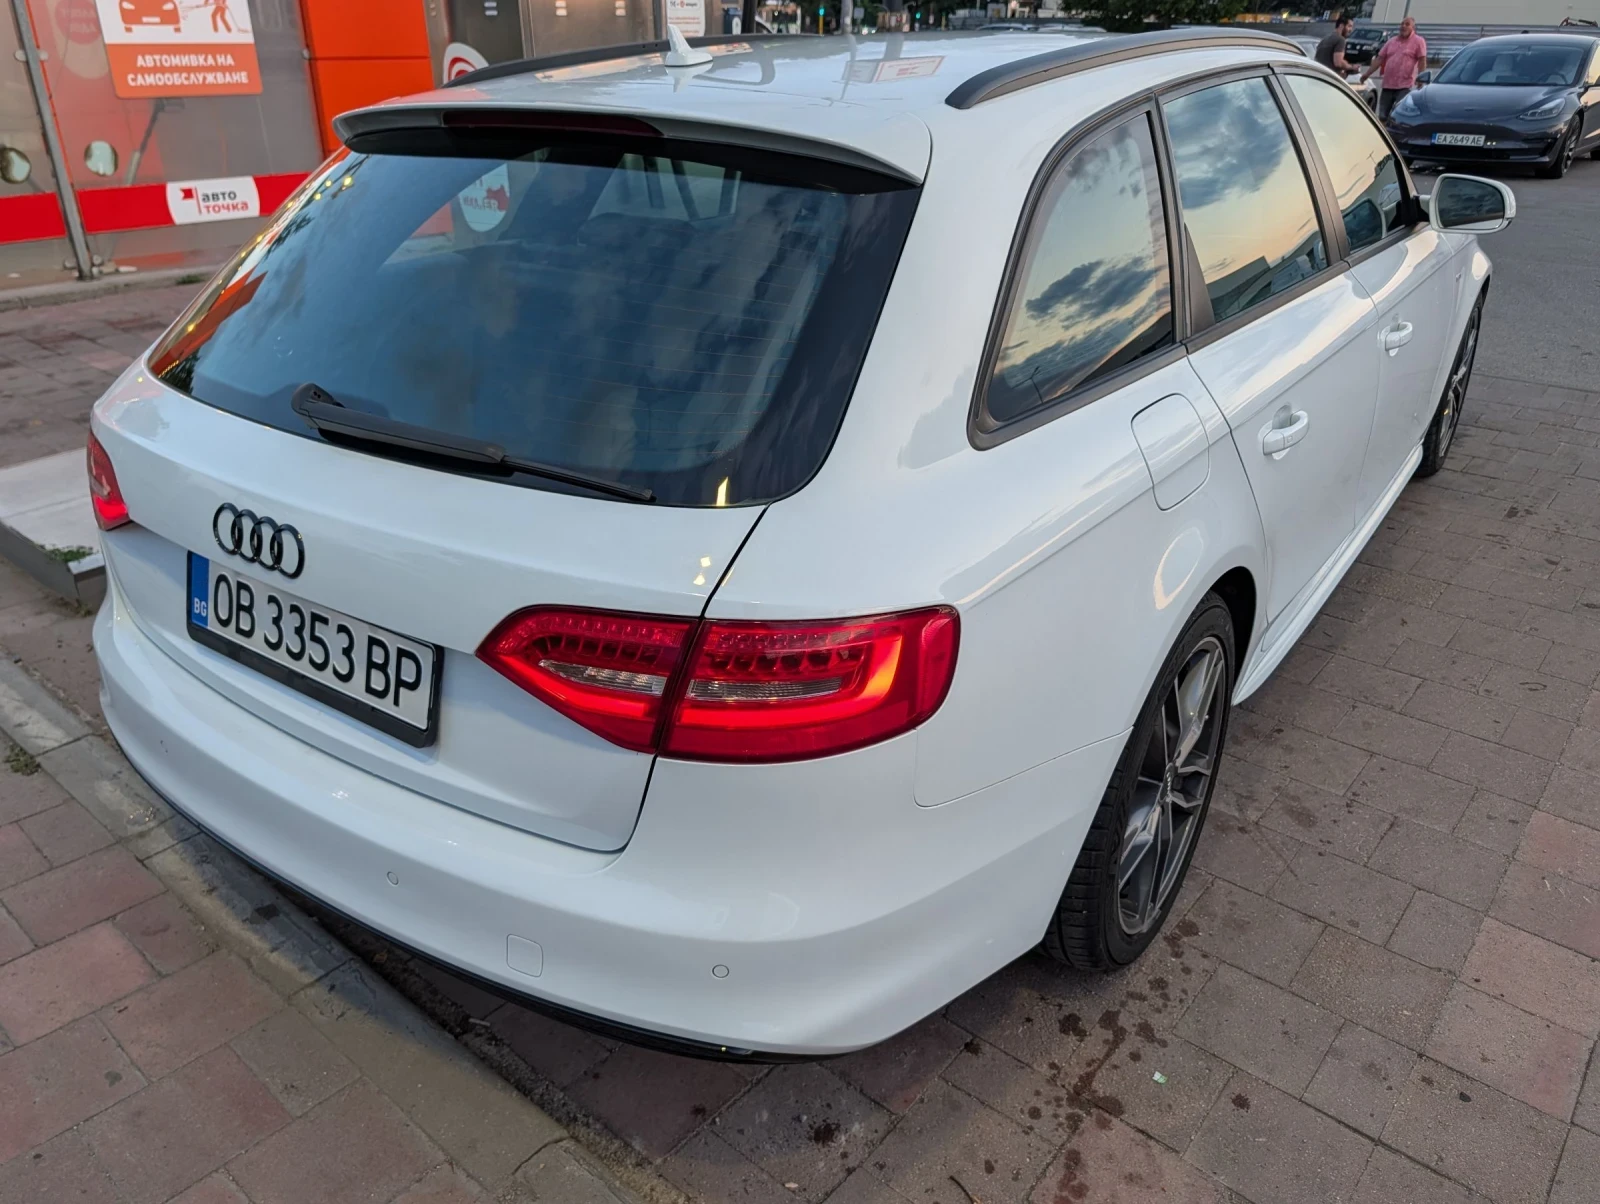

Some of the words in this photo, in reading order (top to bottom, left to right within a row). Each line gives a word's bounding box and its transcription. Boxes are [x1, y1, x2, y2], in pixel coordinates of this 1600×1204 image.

[137, 54, 215, 68] АВТОМИВКА
[216, 54, 235, 67] НА
[127, 71, 249, 87] САМООБСЛУЖВАНЕ
[1436, 134, 1447, 144] EA
[1449, 135, 1470, 145] 2649
[1470, 136, 1483, 146] AE
[201, 191, 237, 203] авто
[205, 200, 249, 214] точка
[193, 597, 208, 617] BG
[213, 574, 256, 639] OB
[263, 594, 356, 684] 3353
[364, 634, 423, 708] BP
